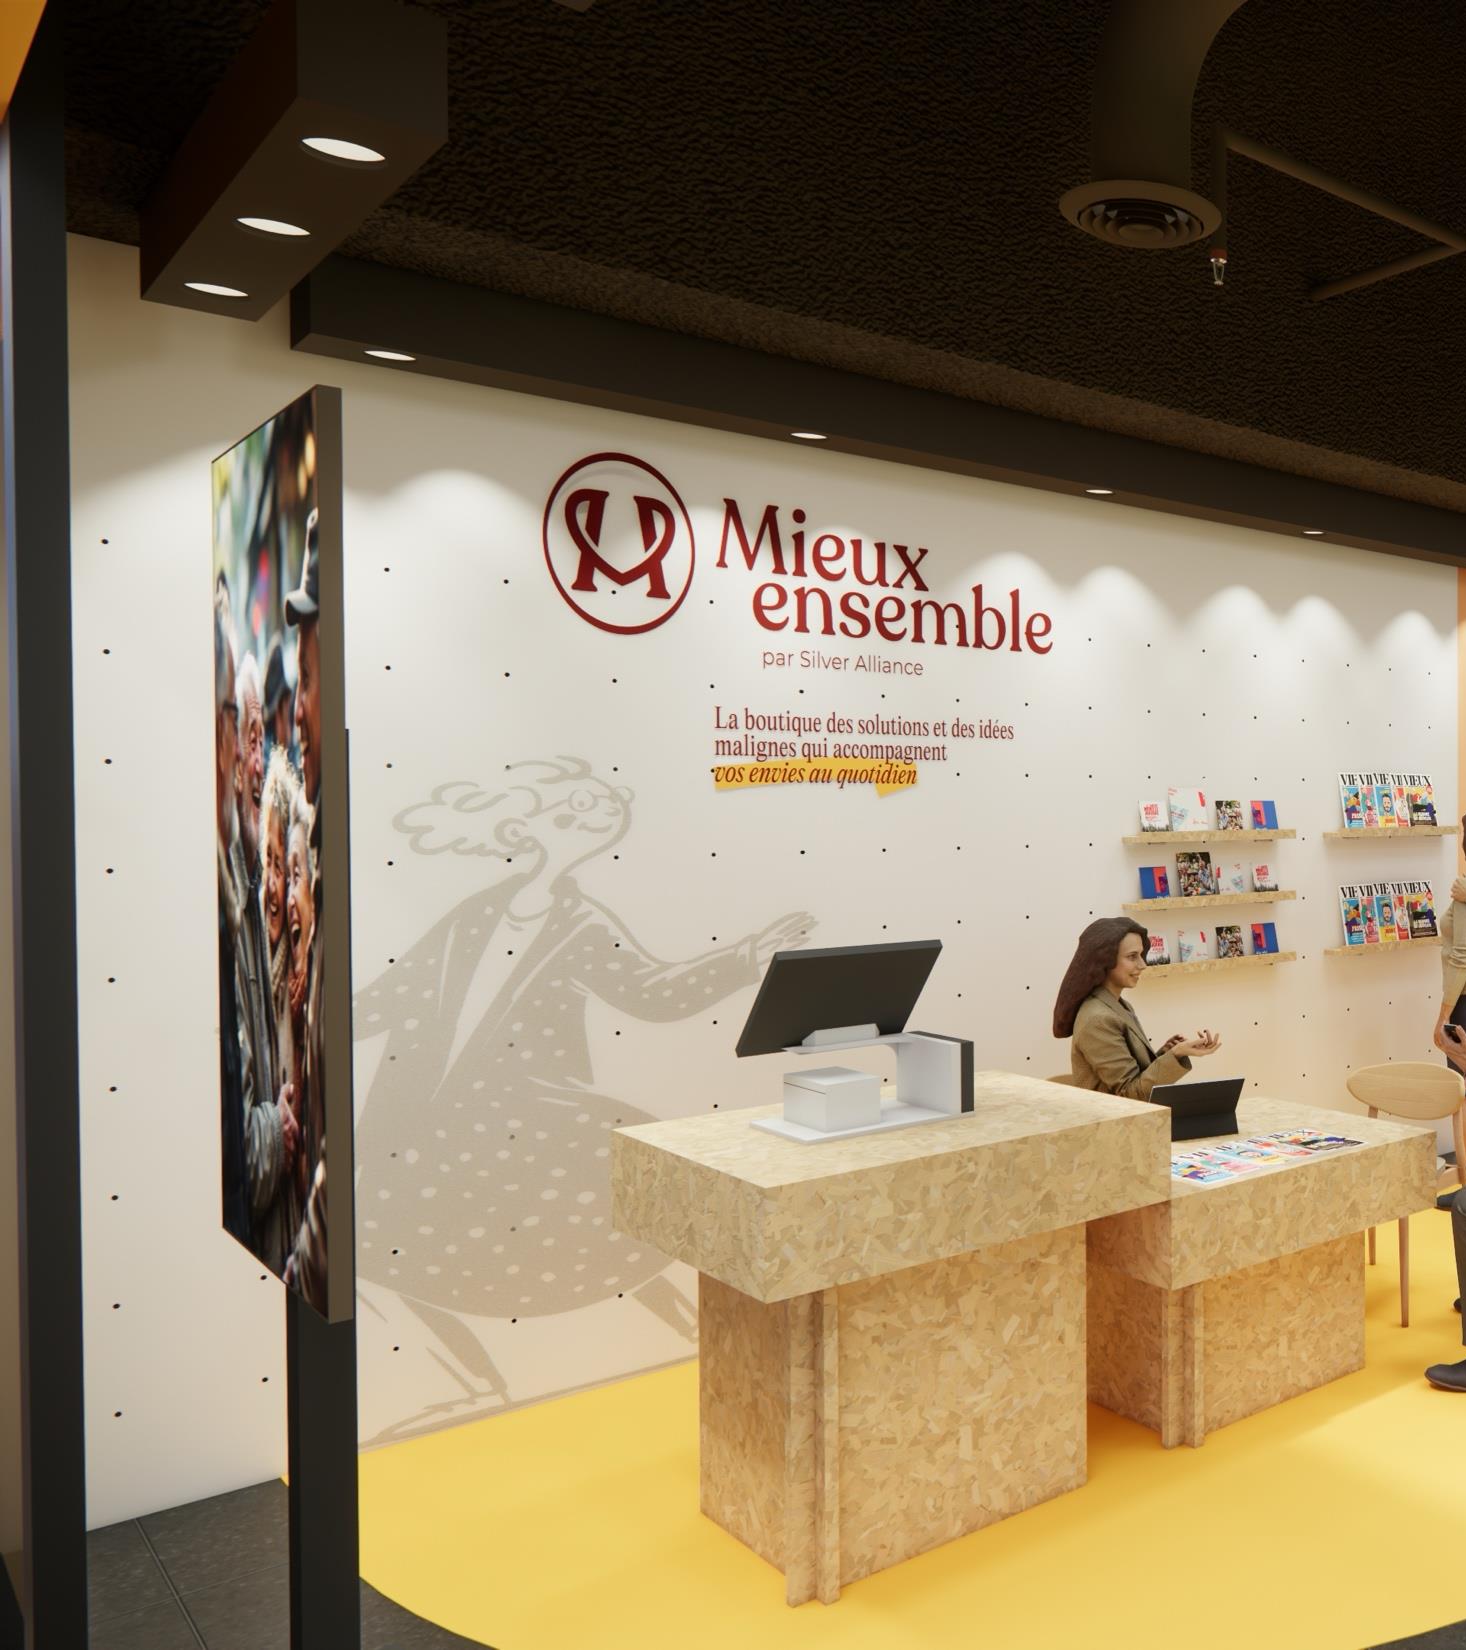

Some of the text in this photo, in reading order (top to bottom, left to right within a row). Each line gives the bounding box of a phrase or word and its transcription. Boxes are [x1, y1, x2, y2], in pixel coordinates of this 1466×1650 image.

[715, 498, 929, 592] Mieux
[751, 582, 1054, 655] ensemble
[762, 650, 924, 676] par Silver Alliance
[714, 706, 1015, 740] La boutique des solutions et des idées
[714, 734, 947, 765] malignes qui accompagnent
[714, 762, 917, 789] vos envies au quotidien
[1403, 774, 1431, 786] VIEUX
[1403, 881, 1431, 894] VIEUX
